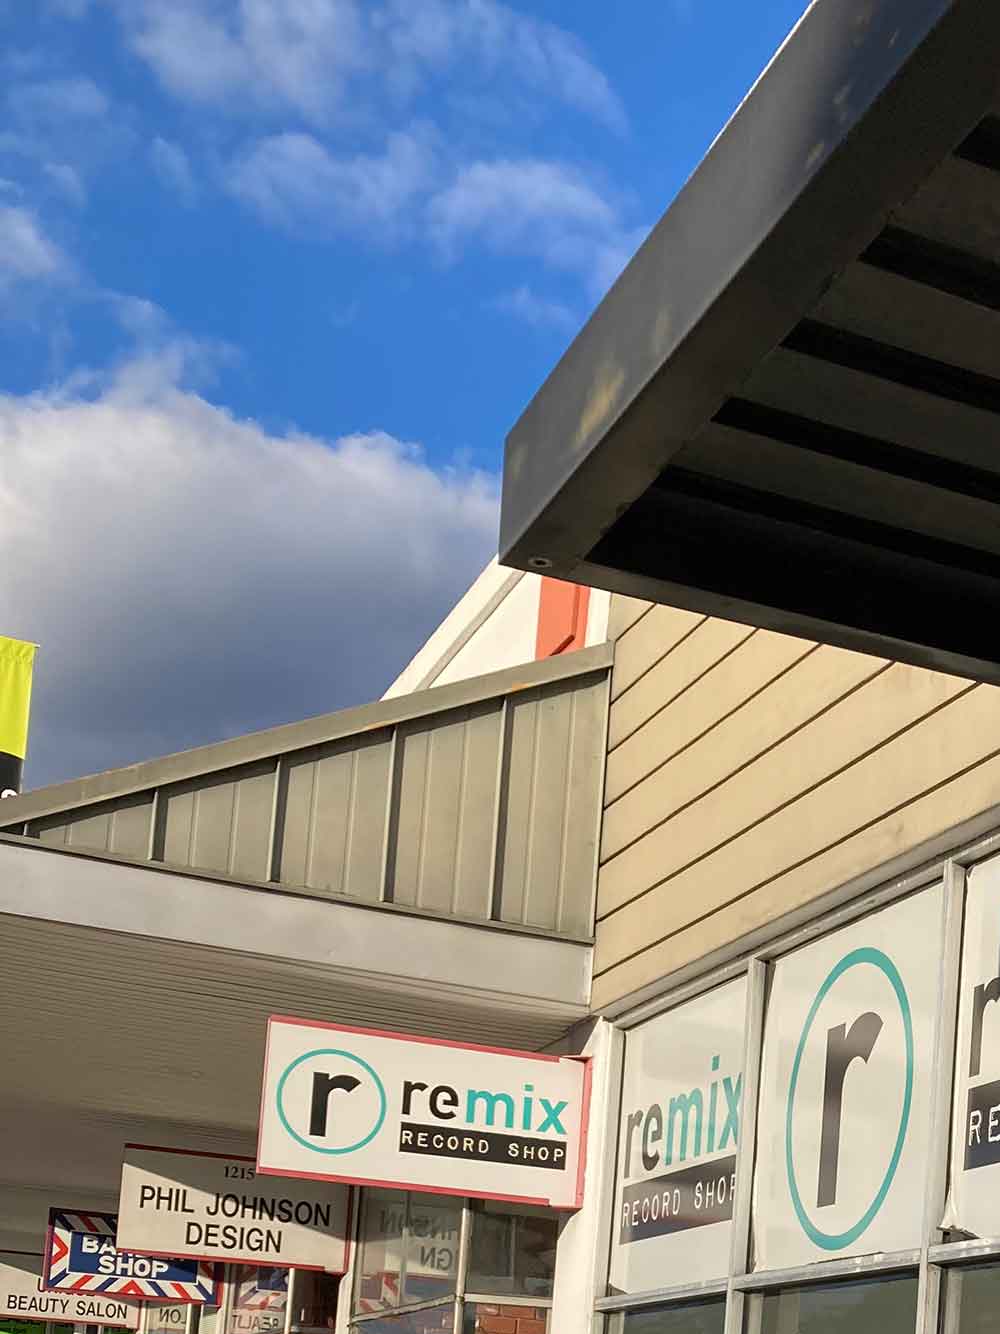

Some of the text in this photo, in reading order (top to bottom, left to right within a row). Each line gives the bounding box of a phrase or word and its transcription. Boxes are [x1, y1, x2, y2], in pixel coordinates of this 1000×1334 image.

[309, 1071, 362, 1137] r
[401, 1080, 569, 1136] remix
[624, 1055, 743, 1179] remix
[816, 1011, 884, 1209] r
[401, 1129, 567, 1163] RECORD SHOP
[223, 1165, 256, 1181] 1215
[139, 1185, 331, 1227] PHIL JOHNSON
[622, 1188, 681, 1228] RECORD
[185, 1222, 282, 1253] DESIGN
[98, 1255, 169, 1278] SHOP
[7, 1295, 128, 1319] BEAUTY SALON
